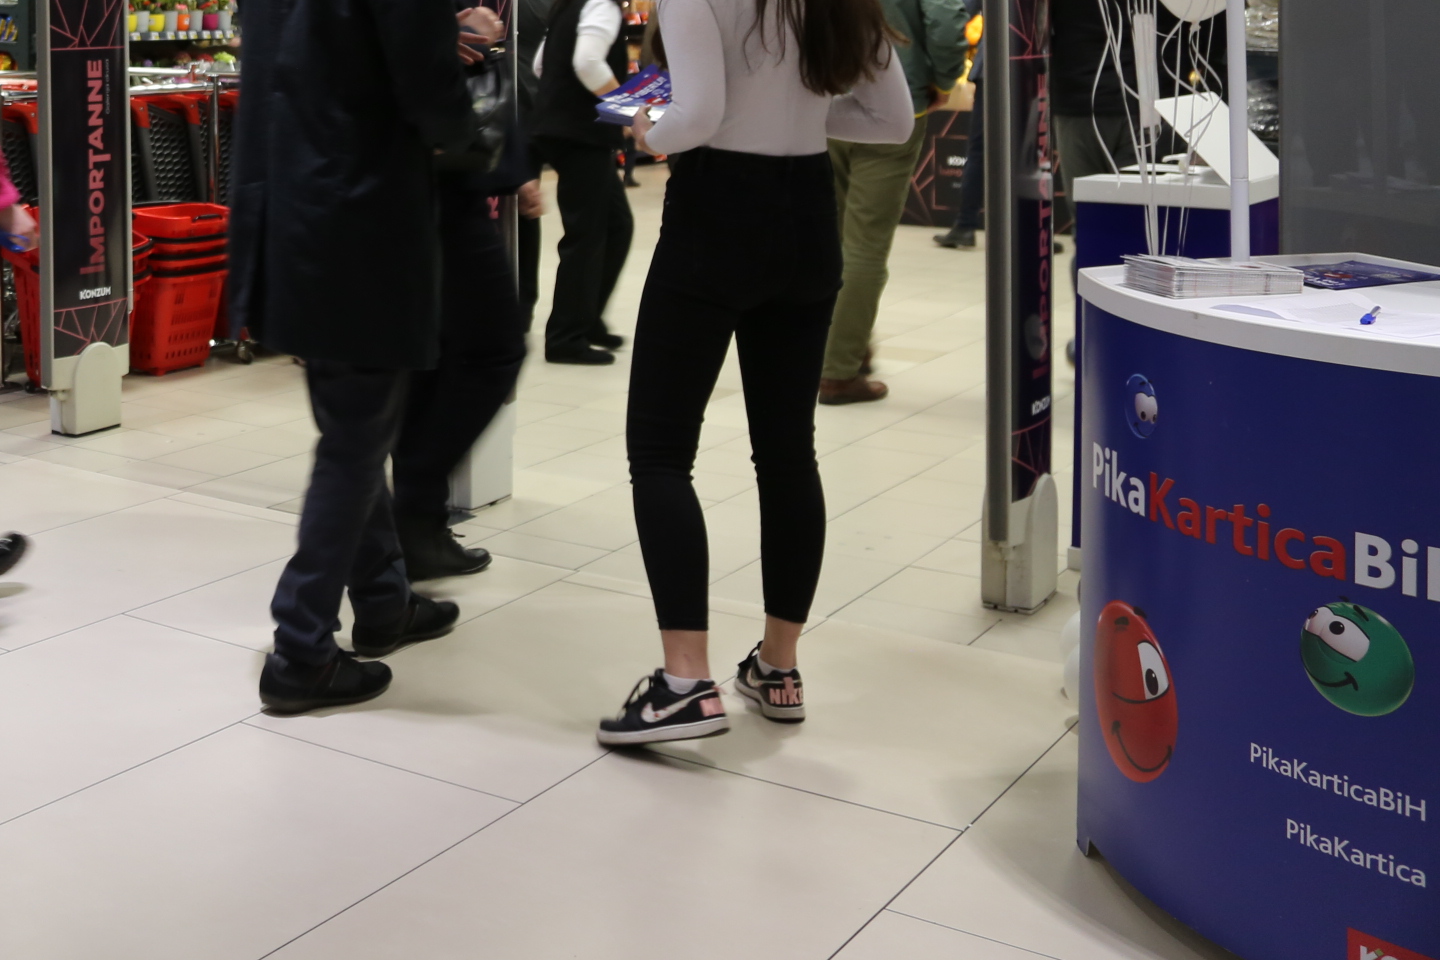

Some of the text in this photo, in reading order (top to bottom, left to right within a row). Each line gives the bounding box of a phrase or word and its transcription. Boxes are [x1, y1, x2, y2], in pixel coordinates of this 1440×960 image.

[80, 59, 111, 275] IMPORTANNE
[79, 286, 111, 300] KONZUM
[1250, 742, 1426, 822] PikaKarticaBiH
[1286, 818, 1426, 888] PikaKartica
